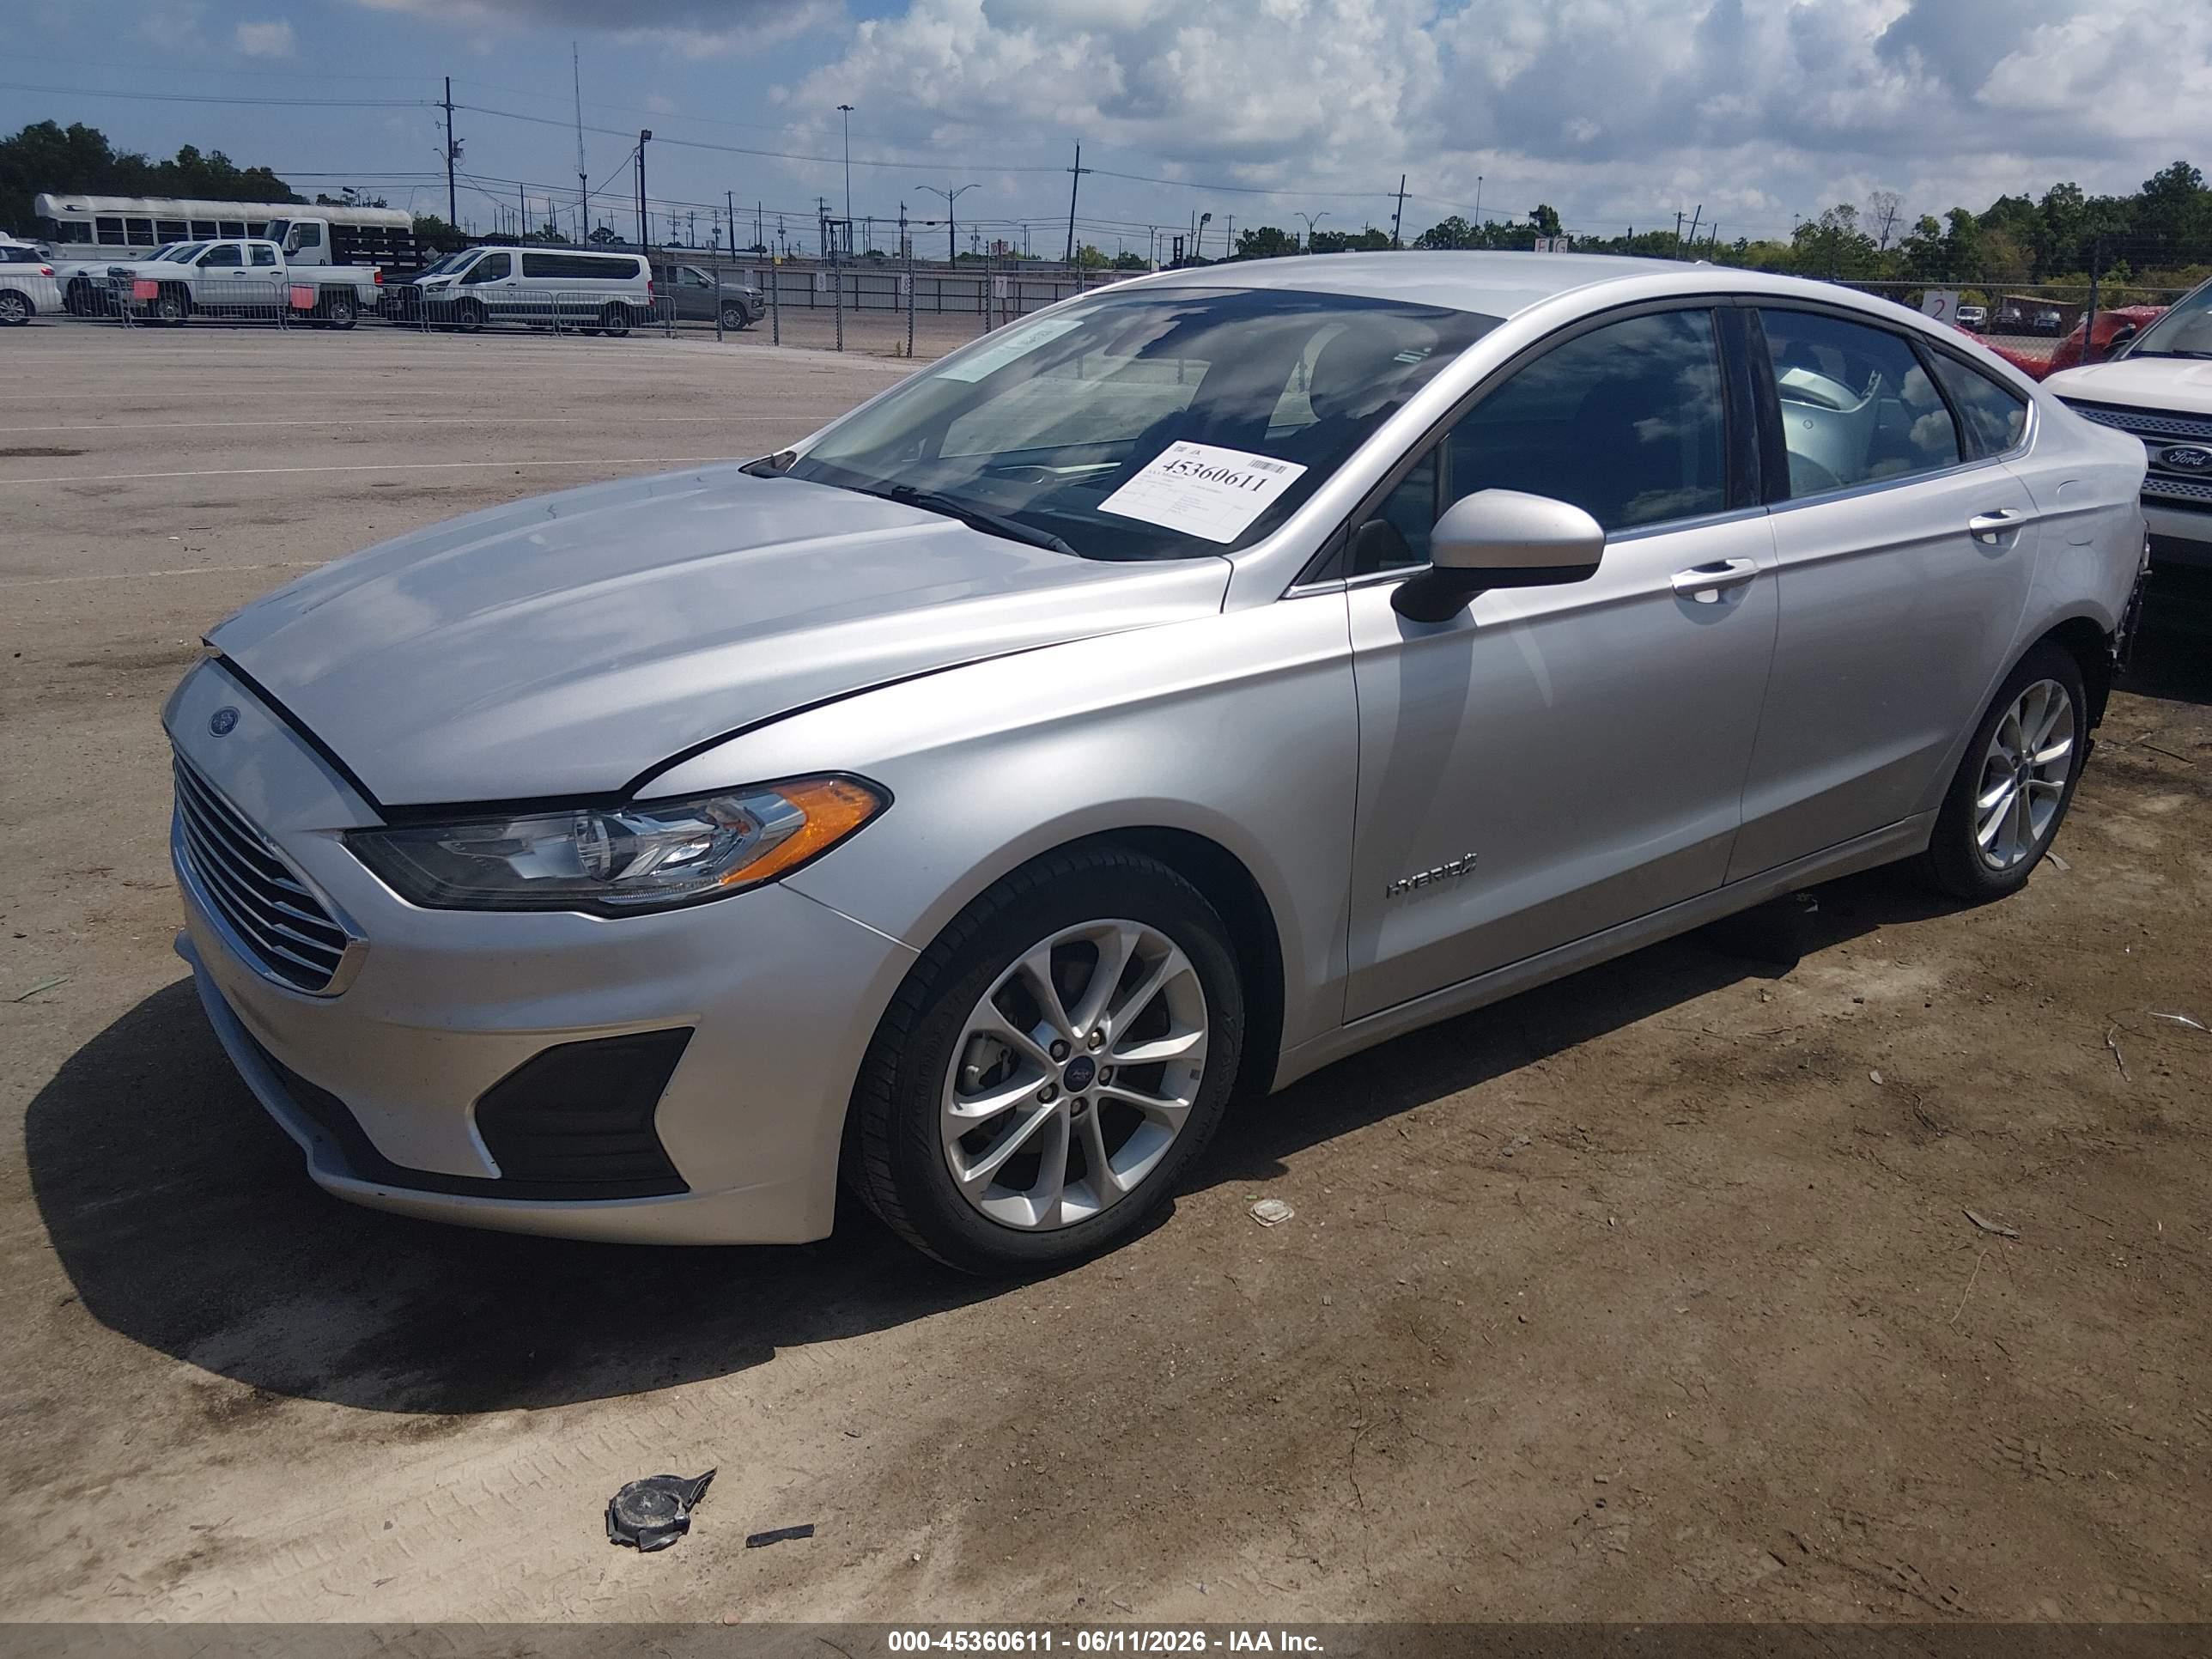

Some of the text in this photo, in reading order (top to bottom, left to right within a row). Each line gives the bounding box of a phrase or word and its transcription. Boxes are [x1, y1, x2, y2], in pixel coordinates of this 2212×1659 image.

[1555, 240, 1565, 253] G
[998, 280, 1004, 293] 7
[1932, 299, 1946, 322] 2
[2169, 450, 2206, 465] Ford
[1162, 459, 1269, 493] 45360611
